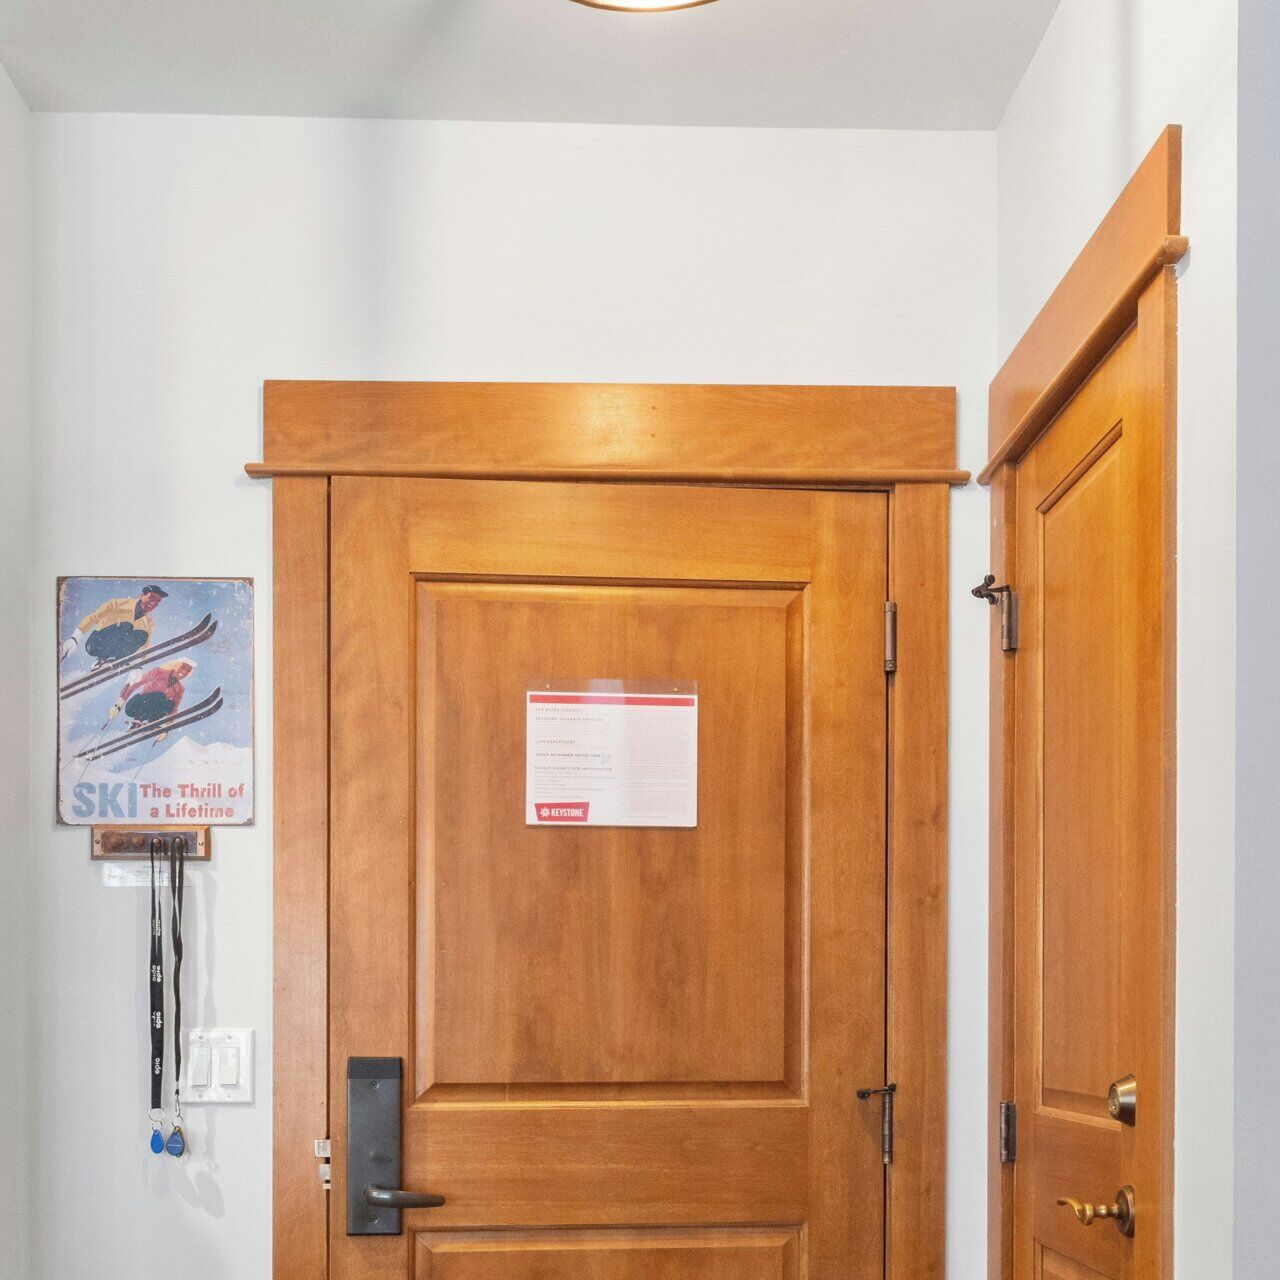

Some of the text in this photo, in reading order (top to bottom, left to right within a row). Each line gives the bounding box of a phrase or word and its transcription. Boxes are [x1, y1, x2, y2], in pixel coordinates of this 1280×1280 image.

[140, 783, 245, 798] The Thrill of
[72, 782, 138, 818] SKI
[150, 804, 234, 818] a Lifetime
[551, 808, 584, 817] KEYSTONE
